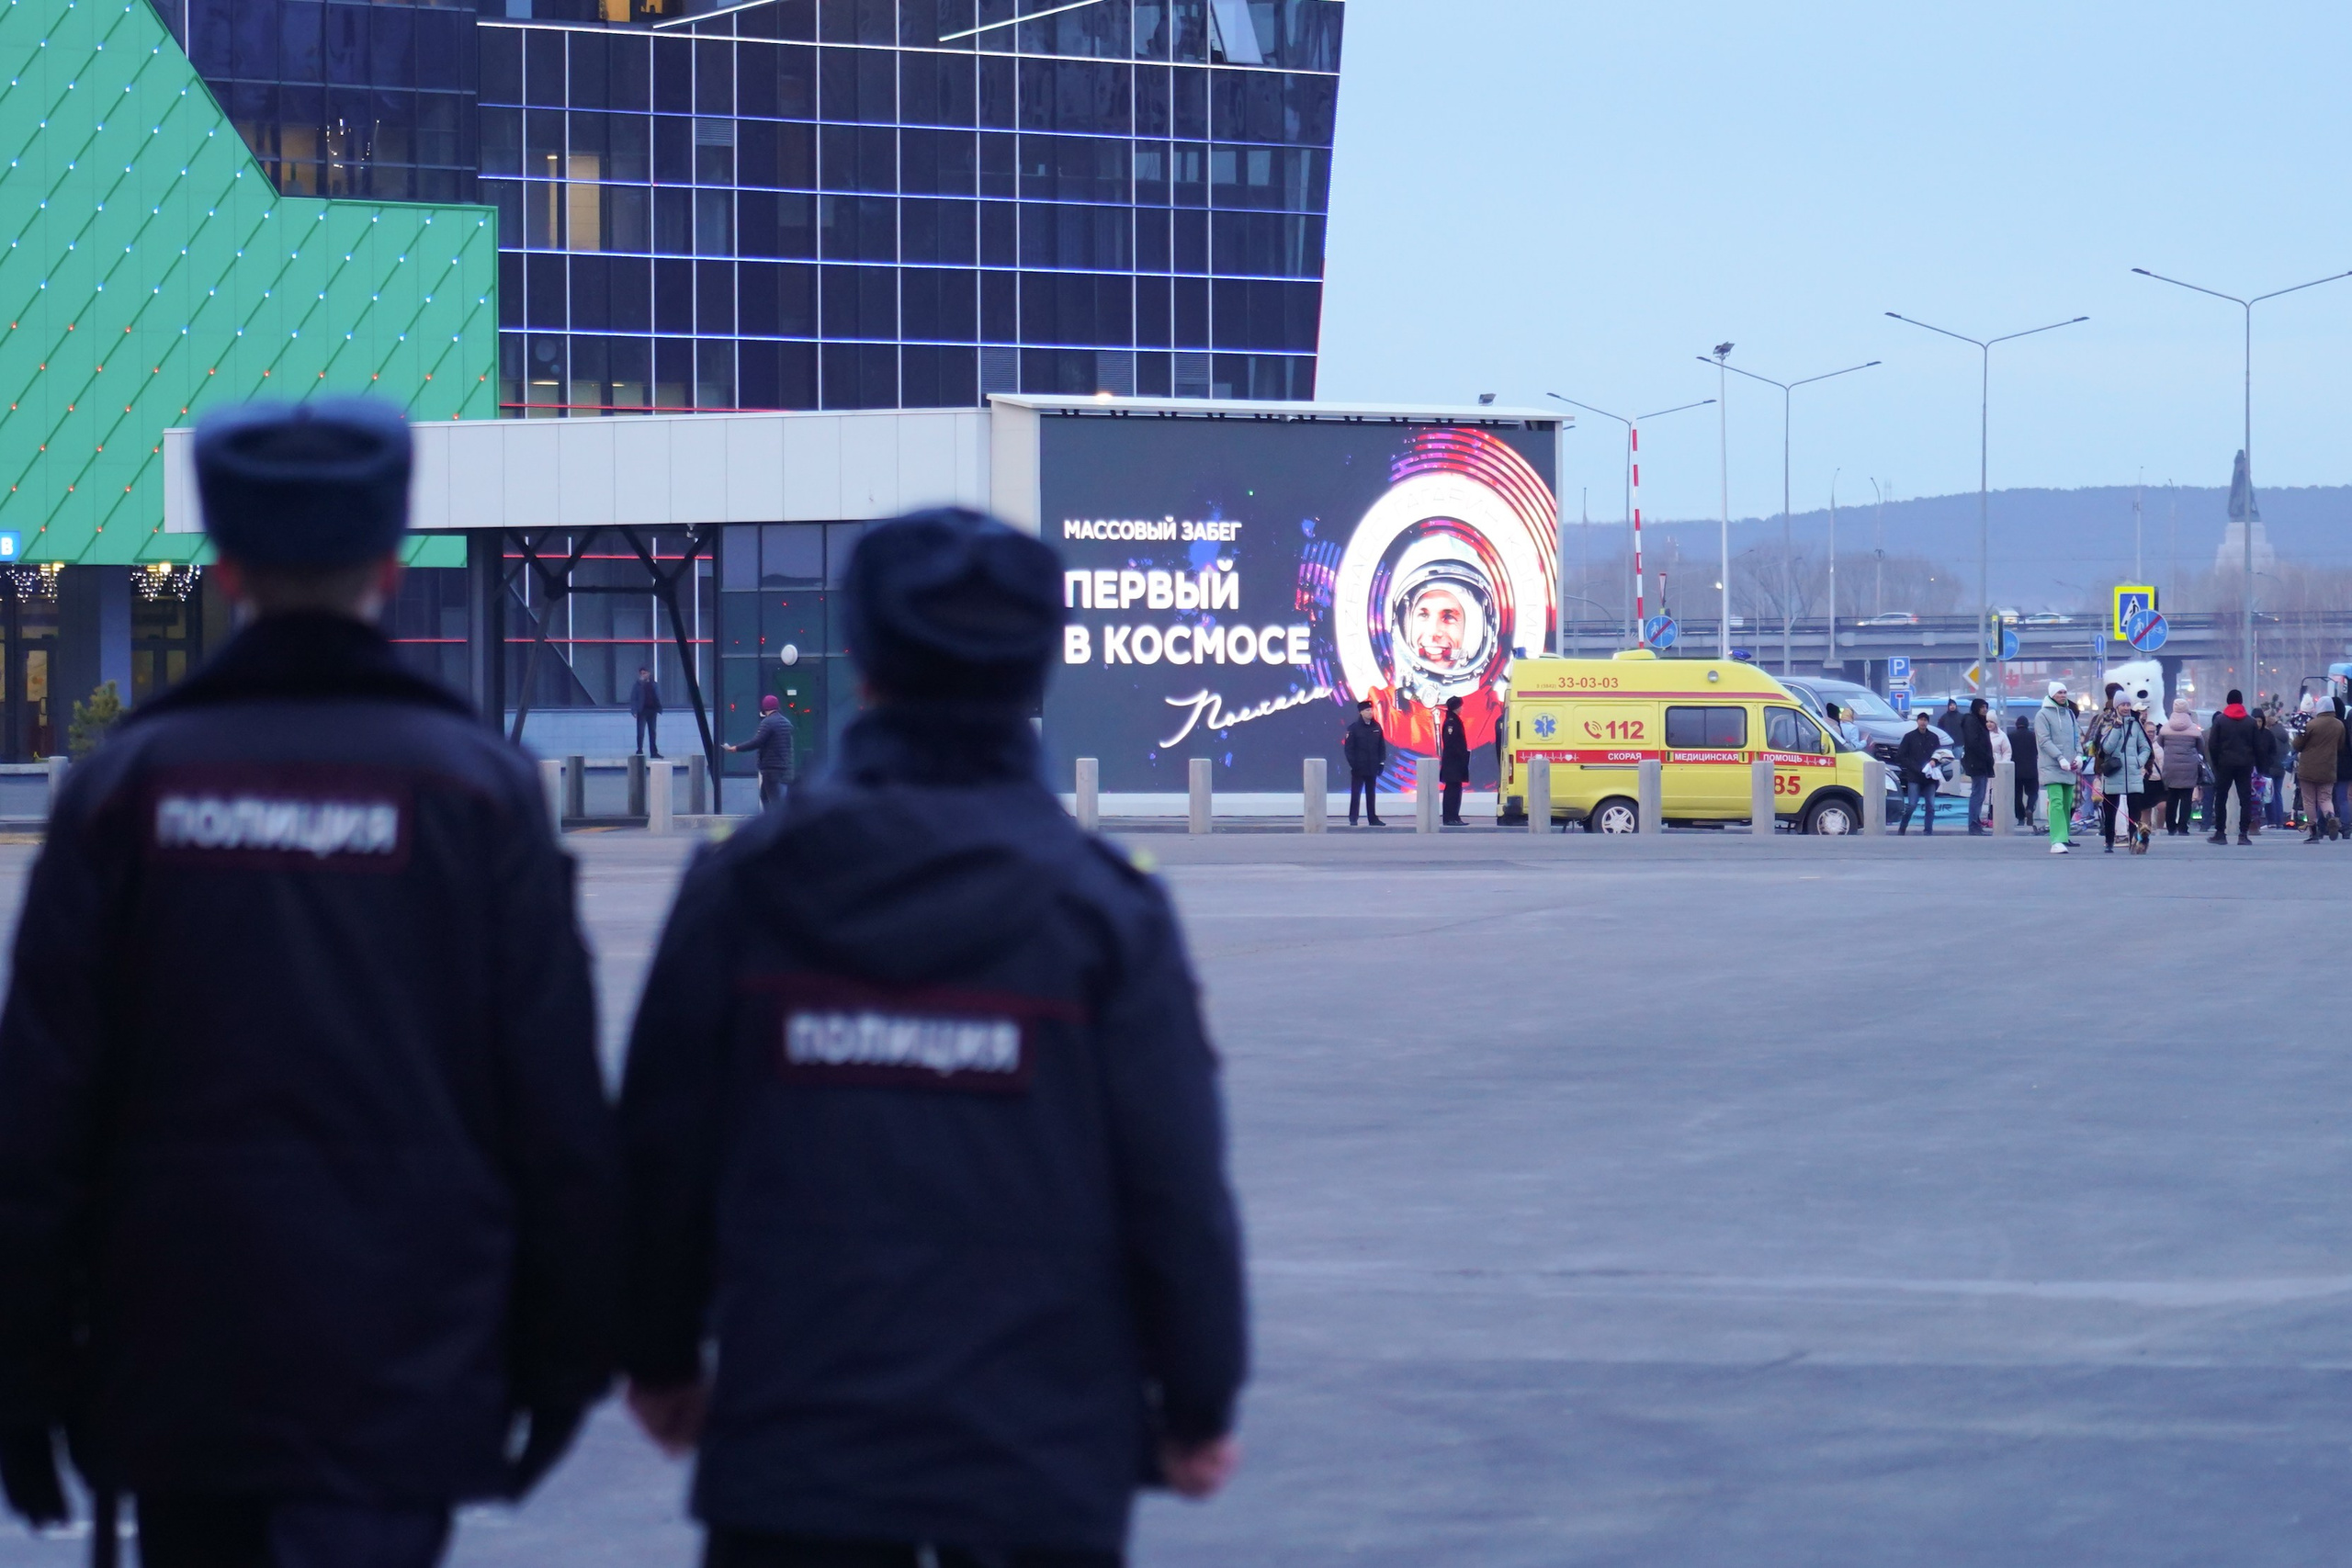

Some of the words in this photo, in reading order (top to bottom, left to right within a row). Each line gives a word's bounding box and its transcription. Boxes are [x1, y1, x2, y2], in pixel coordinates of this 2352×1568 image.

[1064, 516, 1177, 540] МАССОВЫЙ
[1181, 522, 1242, 541] ЗАБЕГ
[1064, 558, 1239, 610] ПЕРВЫЙ
[1064, 625, 1092, 665] В
[1104, 625, 1312, 665] КОСМОСЕ
[1894, 659, 1905, 675] P
[1557, 677, 1619, 689] 33-03-03
[1605, 720, 1645, 739] 112
[1608, 752, 1642, 761] СКОРАЯ
[1674, 753, 1739, 762] МЕДИЦИНСКАЯ
[1763, 753, 1803, 763] ПОМОЩЬ
[157, 795, 399, 857] ПОЛИЦИЯ
[786, 1010, 1021, 1073] ПОЛИЦИЯ
